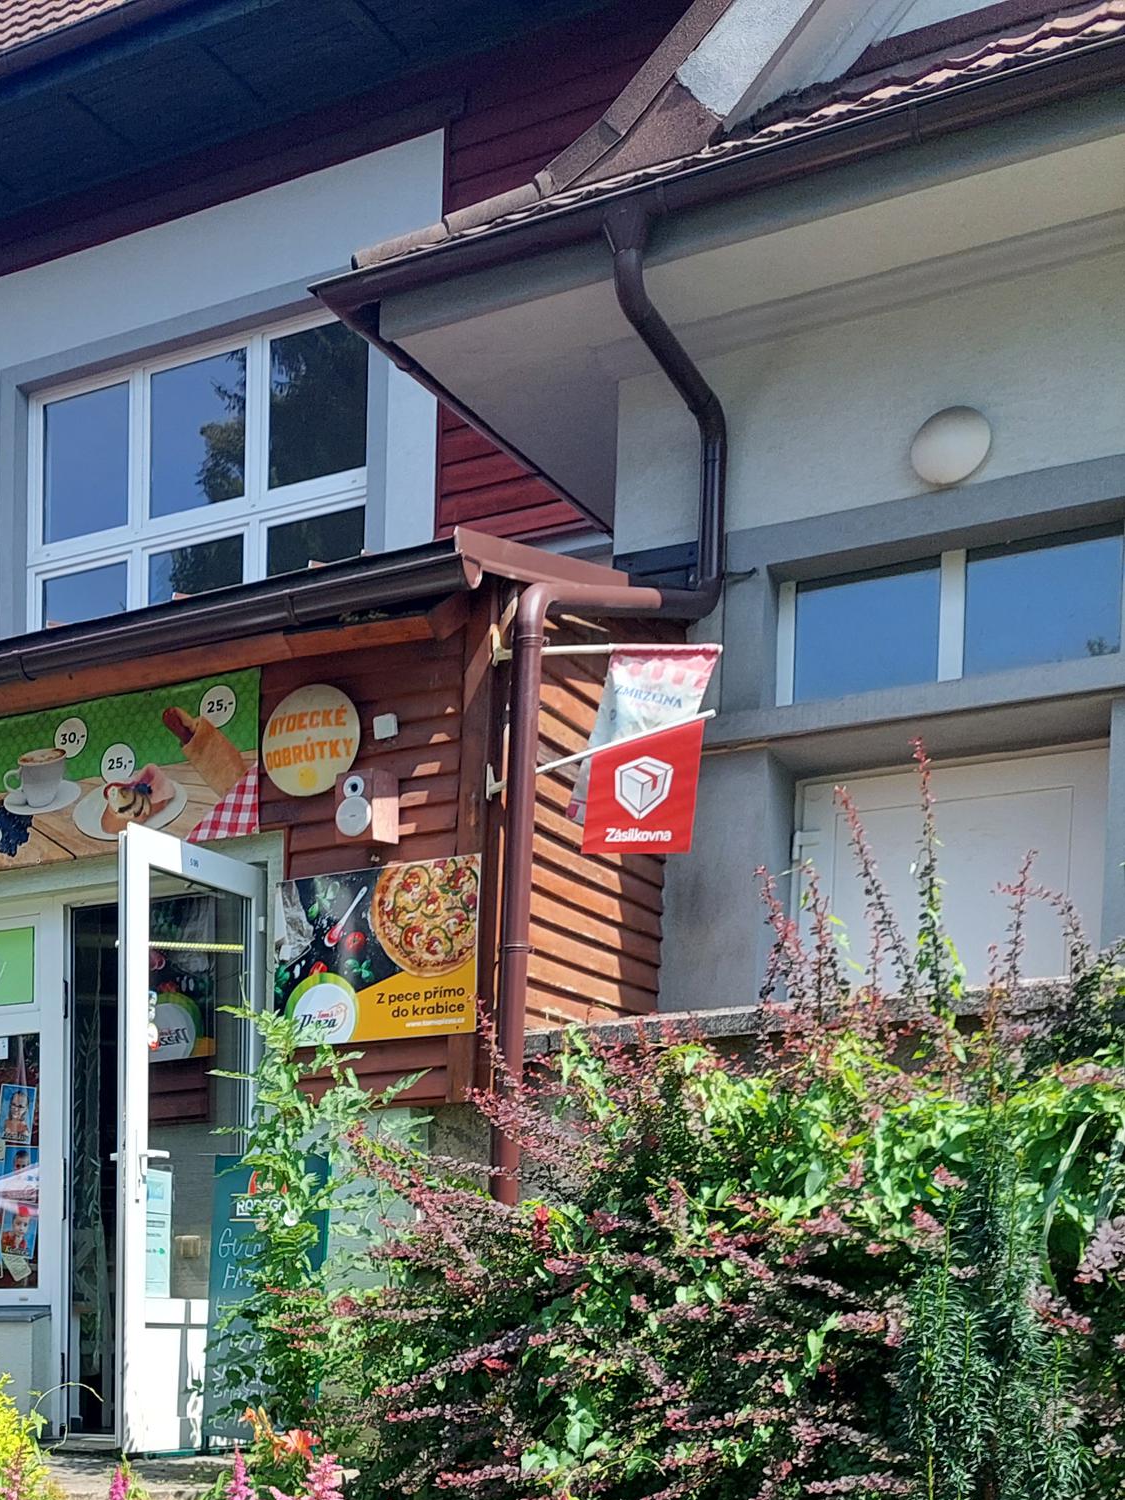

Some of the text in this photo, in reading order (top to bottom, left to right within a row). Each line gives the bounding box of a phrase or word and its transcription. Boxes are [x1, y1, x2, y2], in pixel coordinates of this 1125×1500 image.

[207, 699, 234, 713] 25,-
[60, 732, 86, 745] 30,-
[107, 757, 133, 771] 25,-
[604, 827, 673, 842] Zásilkovna
[376, 986, 466, 1006] Z pece přímo
[391, 1002, 466, 1019] do krabice
